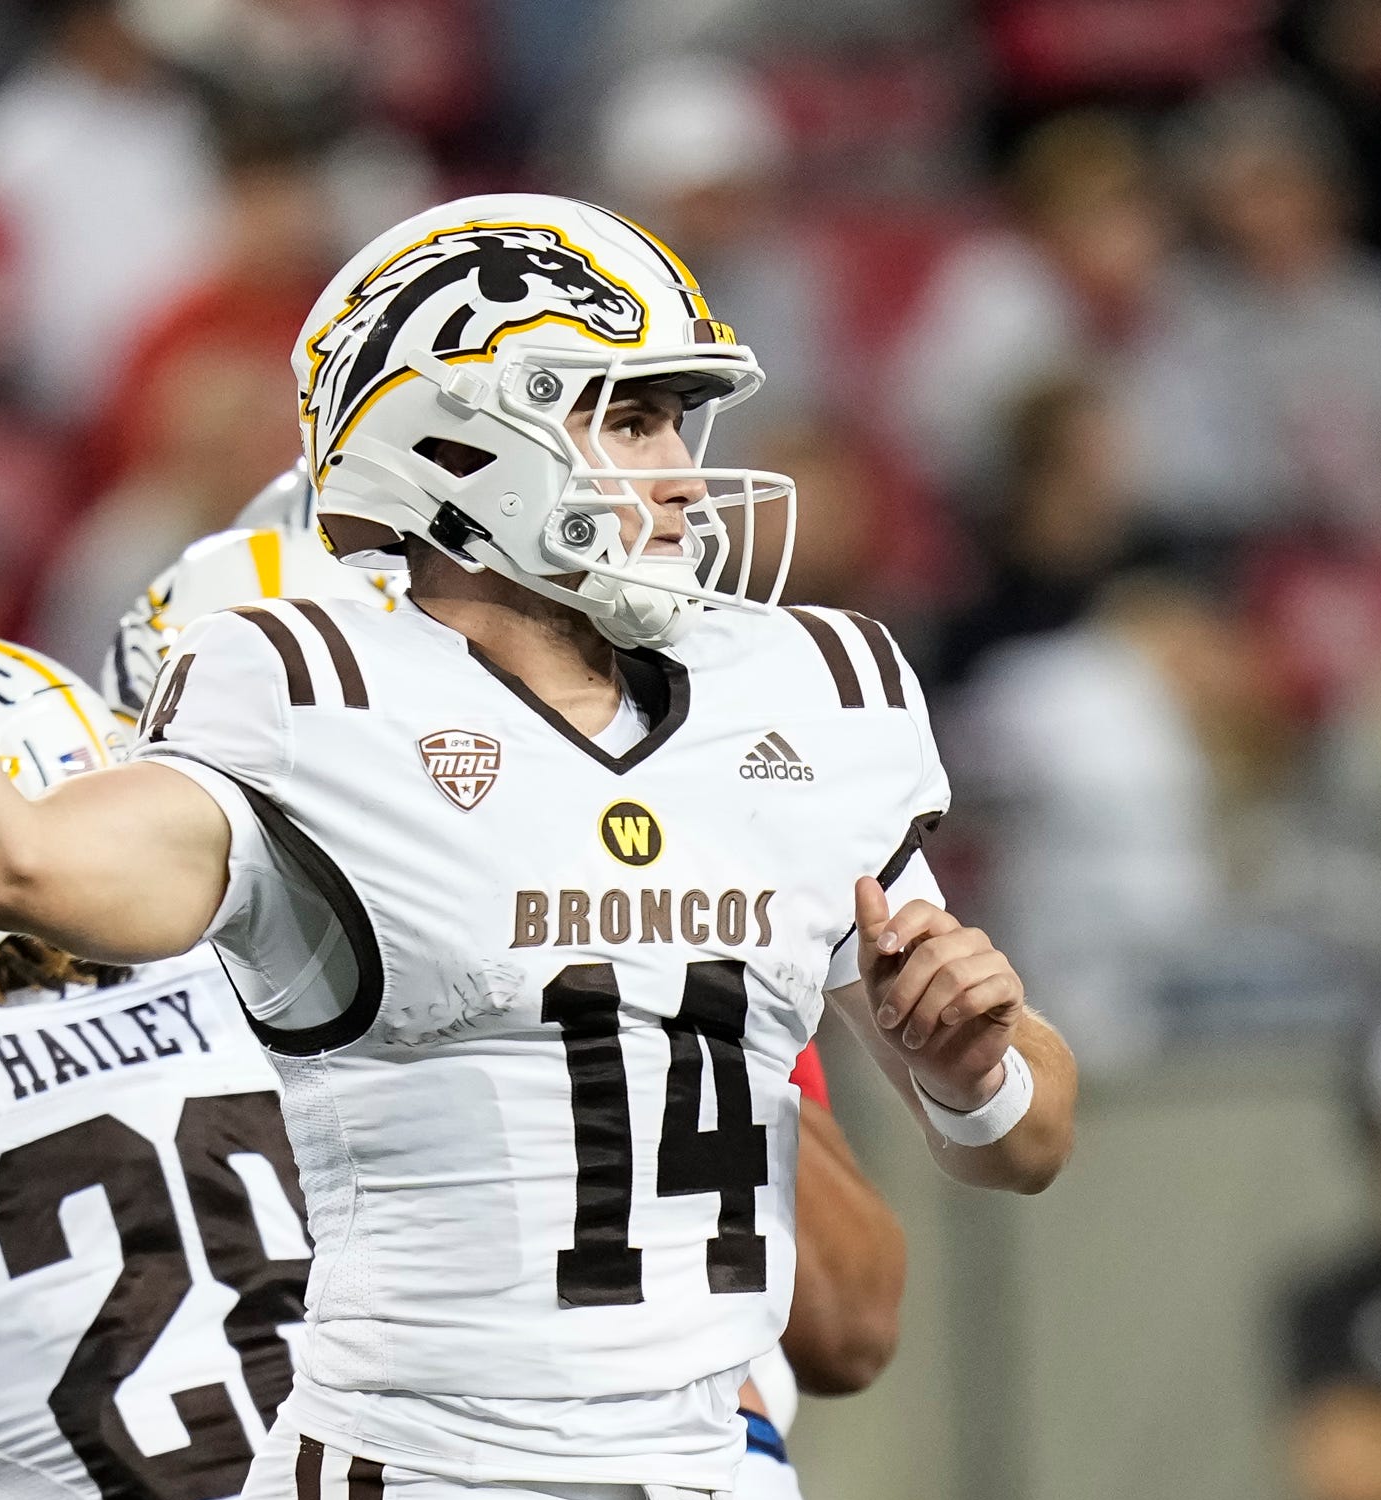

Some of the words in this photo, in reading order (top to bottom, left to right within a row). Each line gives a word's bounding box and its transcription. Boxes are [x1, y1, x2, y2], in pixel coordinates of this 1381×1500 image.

[427, 755, 500, 775] MAC
[739, 760, 815, 782] adidas
[609, 815, 652, 857] W
[509, 888, 776, 950] BRONCOS
[540, 959, 769, 1308] 14
